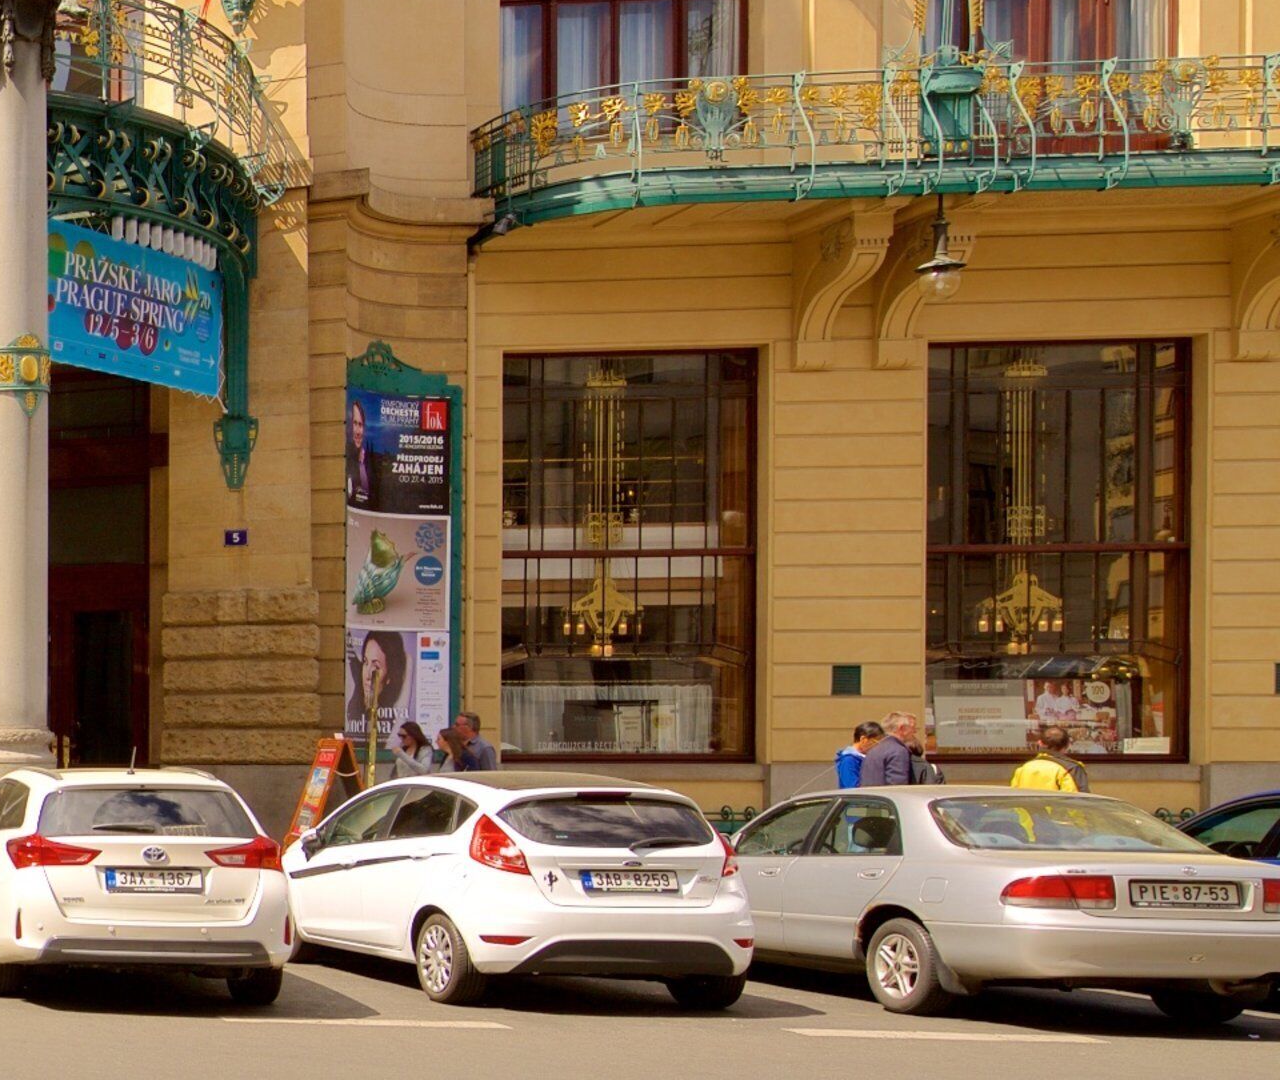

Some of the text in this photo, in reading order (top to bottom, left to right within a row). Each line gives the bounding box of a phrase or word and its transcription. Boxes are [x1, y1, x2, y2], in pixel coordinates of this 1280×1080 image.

[64, 250, 182, 306] PRAŽSKÉ JARO
[55, 277, 127, 318] PRAGUE
[129, 295, 184, 333] SPRING
[200, 290, 211, 310] 70
[380, 407, 420, 418] ORCHESTR
[425, 403, 443, 430] fok
[399, 434, 444, 445] 2015/2016
[396, 453, 444, 463] PŘEDPRODEJ
[391, 461, 443, 475] ZAHÁJEN
[398, 475, 410, 483] OD
[428, 476, 443, 485] 2015
[232, 532, 240, 543] 5
[120, 872, 194, 886] 3AX 1367
[596, 873, 671, 887] 3AB 8259
[1139, 885, 1230, 902] PIE 87-53
